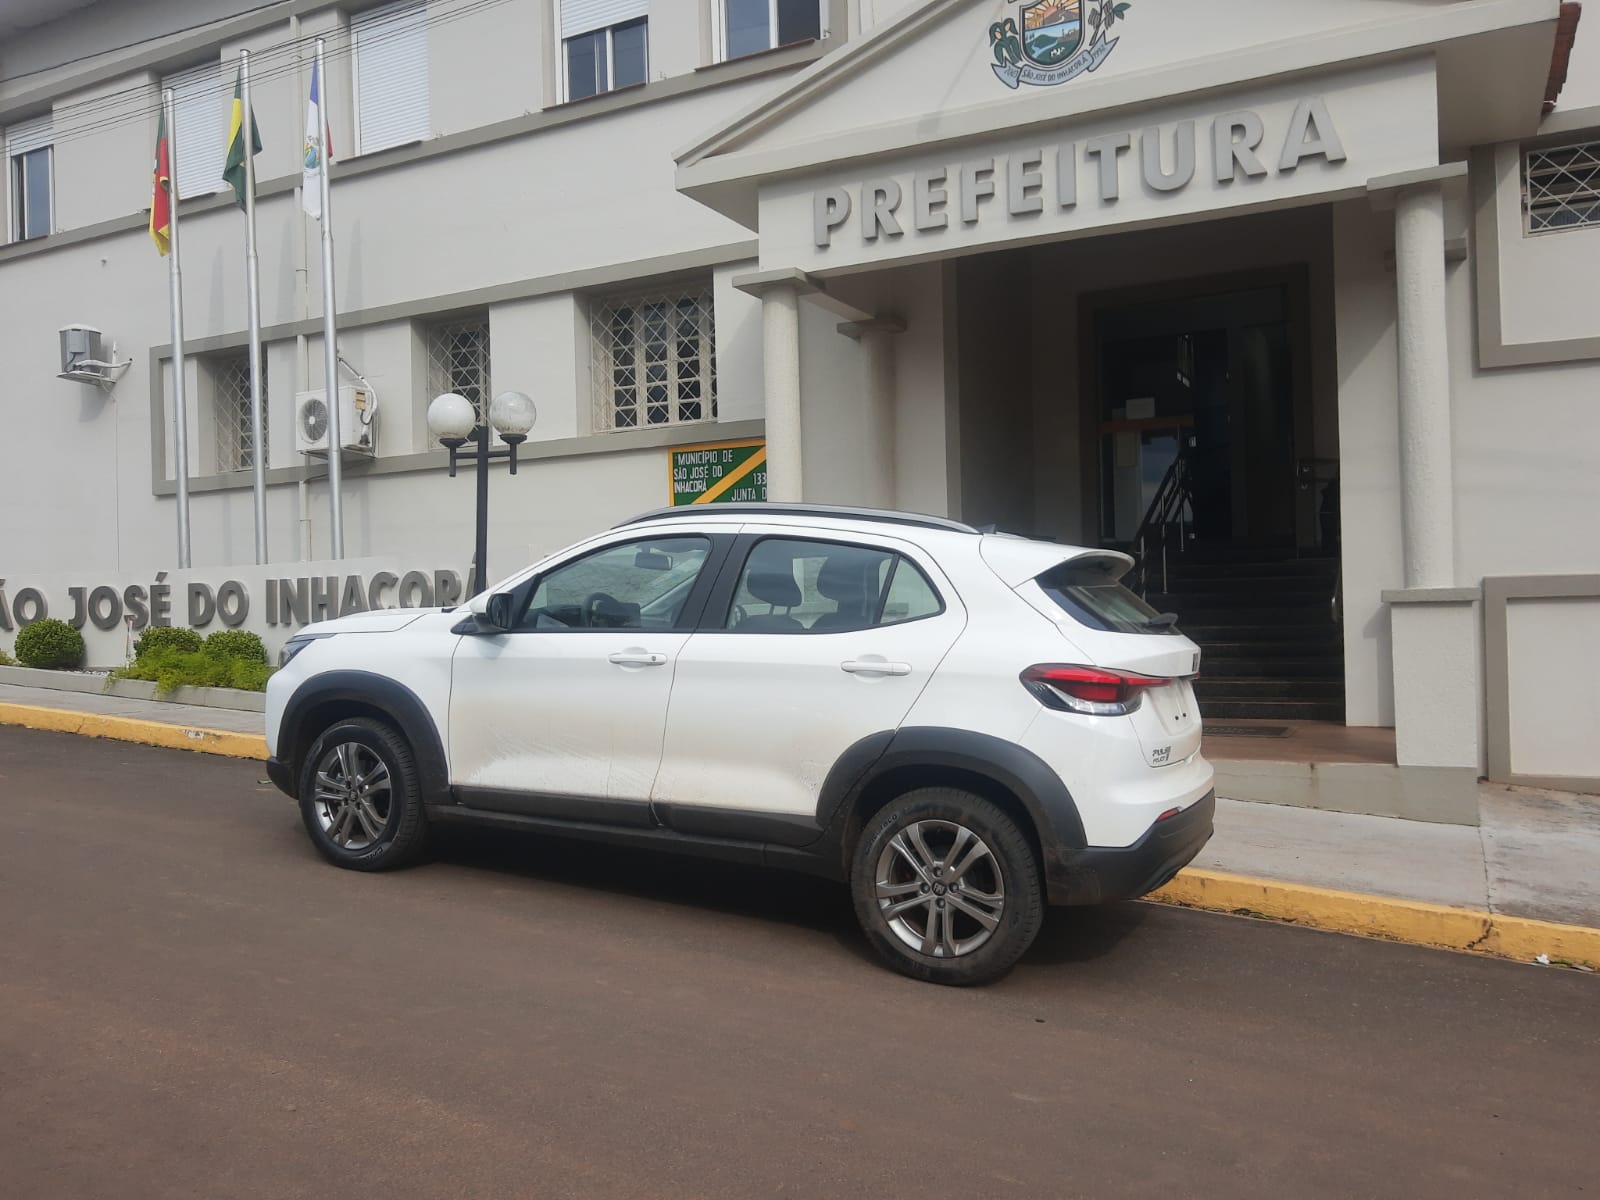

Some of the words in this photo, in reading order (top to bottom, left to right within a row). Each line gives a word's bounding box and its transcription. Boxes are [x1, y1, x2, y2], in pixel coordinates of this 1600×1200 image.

[811, 97, 1347, 248] PREFEITURA
[677, 450, 718, 466] MUNICÍPIO
[722, 449, 733, 463] DE
[690, 464, 709, 479] JOSÉ
[712, 465, 723, 478] DO
[731, 487, 756, 501] JUNTA
[68, 571, 172, 632] JOSÉ
[188, 580, 250, 628] DO
